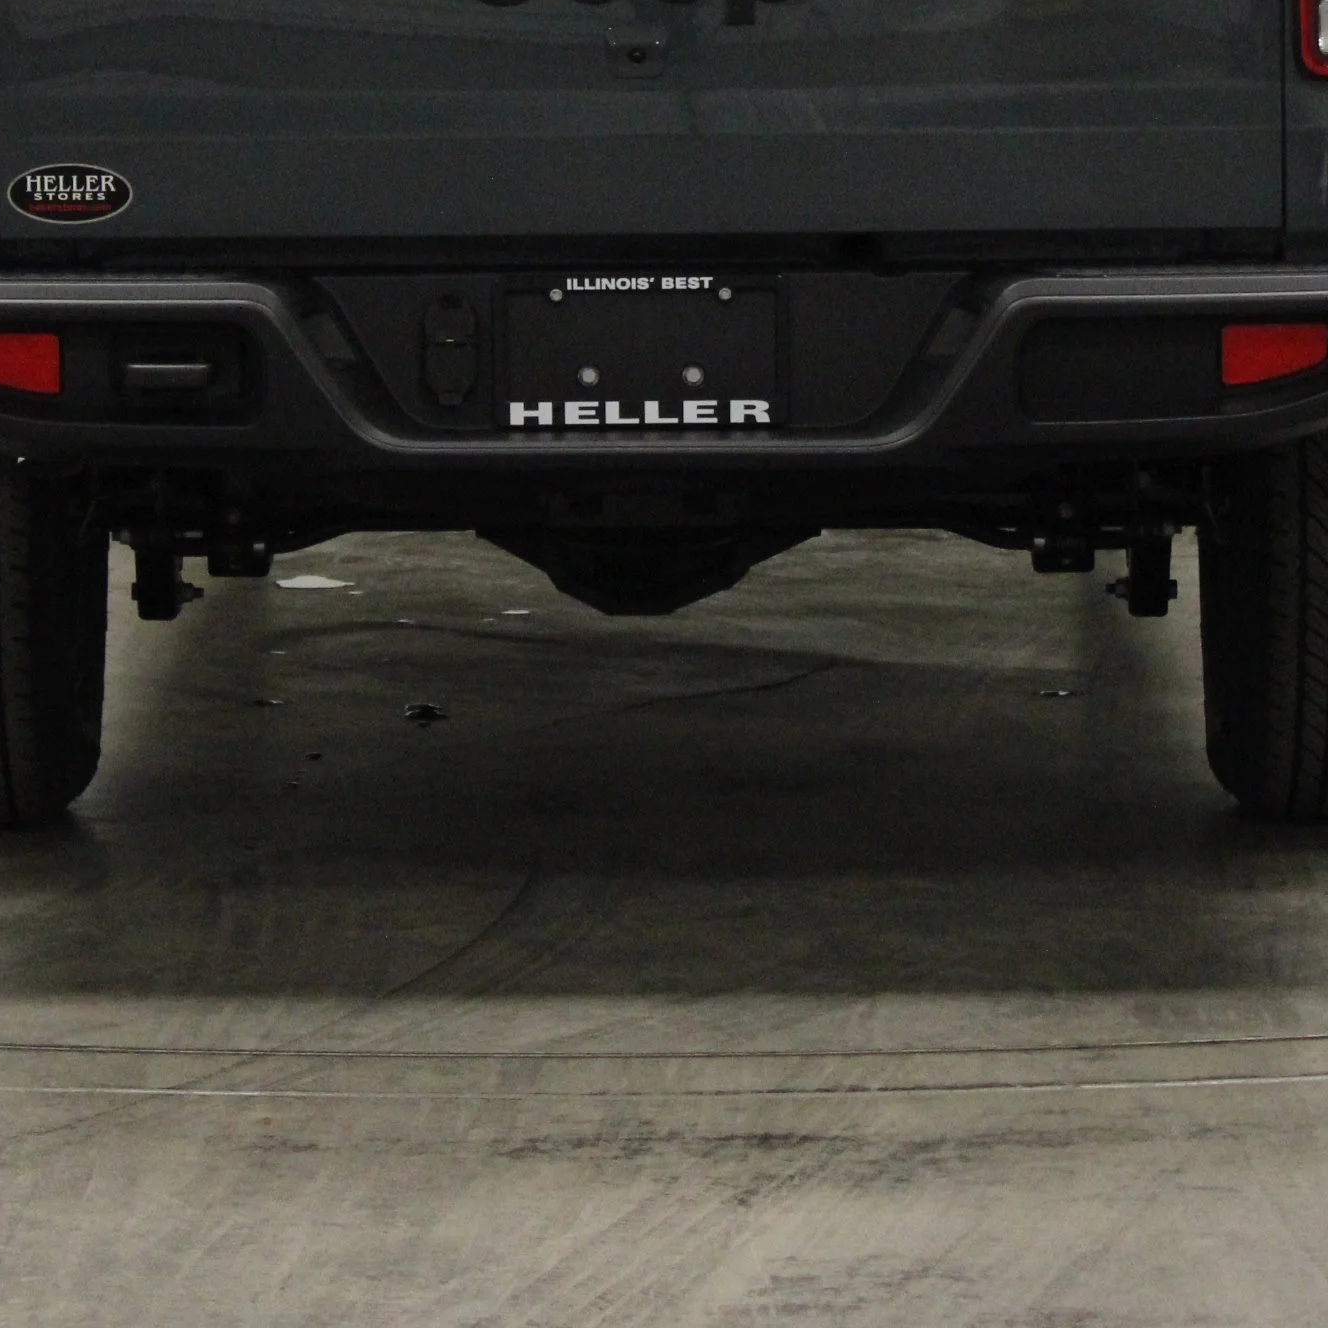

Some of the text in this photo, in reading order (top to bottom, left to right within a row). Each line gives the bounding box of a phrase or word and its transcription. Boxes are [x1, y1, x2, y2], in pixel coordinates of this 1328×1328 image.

[25, 174, 116, 193] HELLER
[33, 192, 106, 201] STORES
[661, 276, 714, 289] BEST
[509, 399, 771, 425] HELLER
